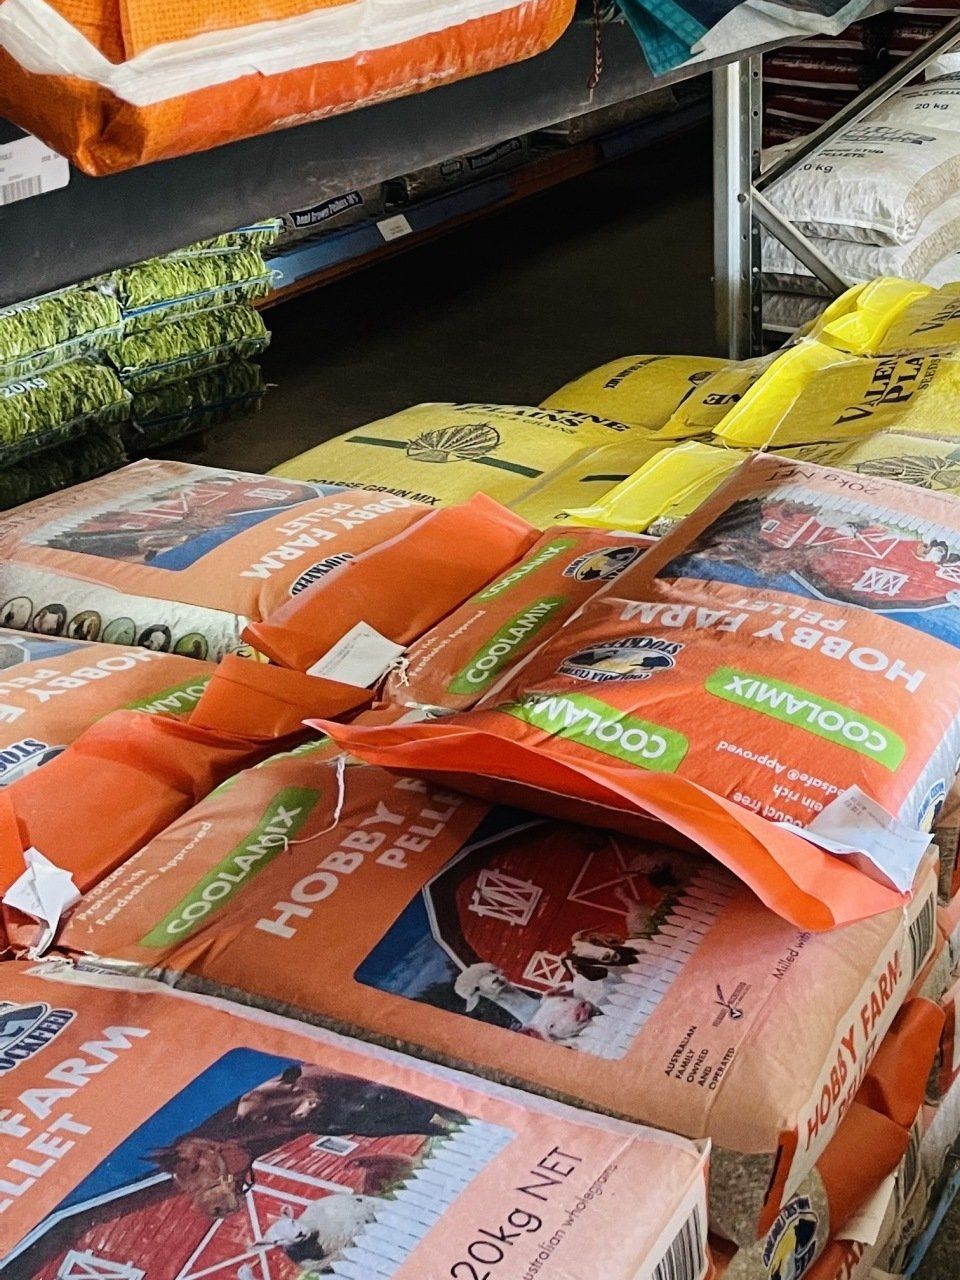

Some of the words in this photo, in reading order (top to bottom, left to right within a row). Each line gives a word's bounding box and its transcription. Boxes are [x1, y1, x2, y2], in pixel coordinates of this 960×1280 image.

[914, 102, 930, 111] 20
[933, 102, 950, 111] kg
[815, 164, 833, 173] kg
[363, 482, 408, 499] GRAIN
[409, 490, 442, 506] MIX
[822, 474, 880, 496] 20kg
[273, 502, 354, 542] PELLET
[239, 527, 340, 580] FARM
[480, 544, 567, 601] COOLAMIX
[619, 602, 750, 634] FARM
[725, 597, 848, 632] PELLET
[466, 600, 559, 684] COOLAMIX
[754, 619, 926, 694] HOBBY
[26, 650, 160, 704] HOBBY
[724, 674, 888, 753] COOLAMIX
[716, 740, 787, 773] Approved
[732, 790, 760, 807] free
[773, 783, 800, 800] rich
[160, 821, 212, 874] Approved
[166, 805, 304, 935] COOLAMIX
[255, 801, 406, 940] HOBBY
[772, 948, 799, 981] Milled
[664, 1025, 698, 1077] AUSTRALIAN
[675, 1049, 696, 1080] FAMILY
[686, 1048, 710, 1084] OWNED
[708, 1047, 736, 1091] OPERATED
[0, 1026, 152, 1139] FARM
[697, 1066, 713, 1088] AND
[806, 1024, 857, 1153] HOBBY
[450, 1207, 543, 1280] 20kg
[516, 1145, 583, 1202] NET
